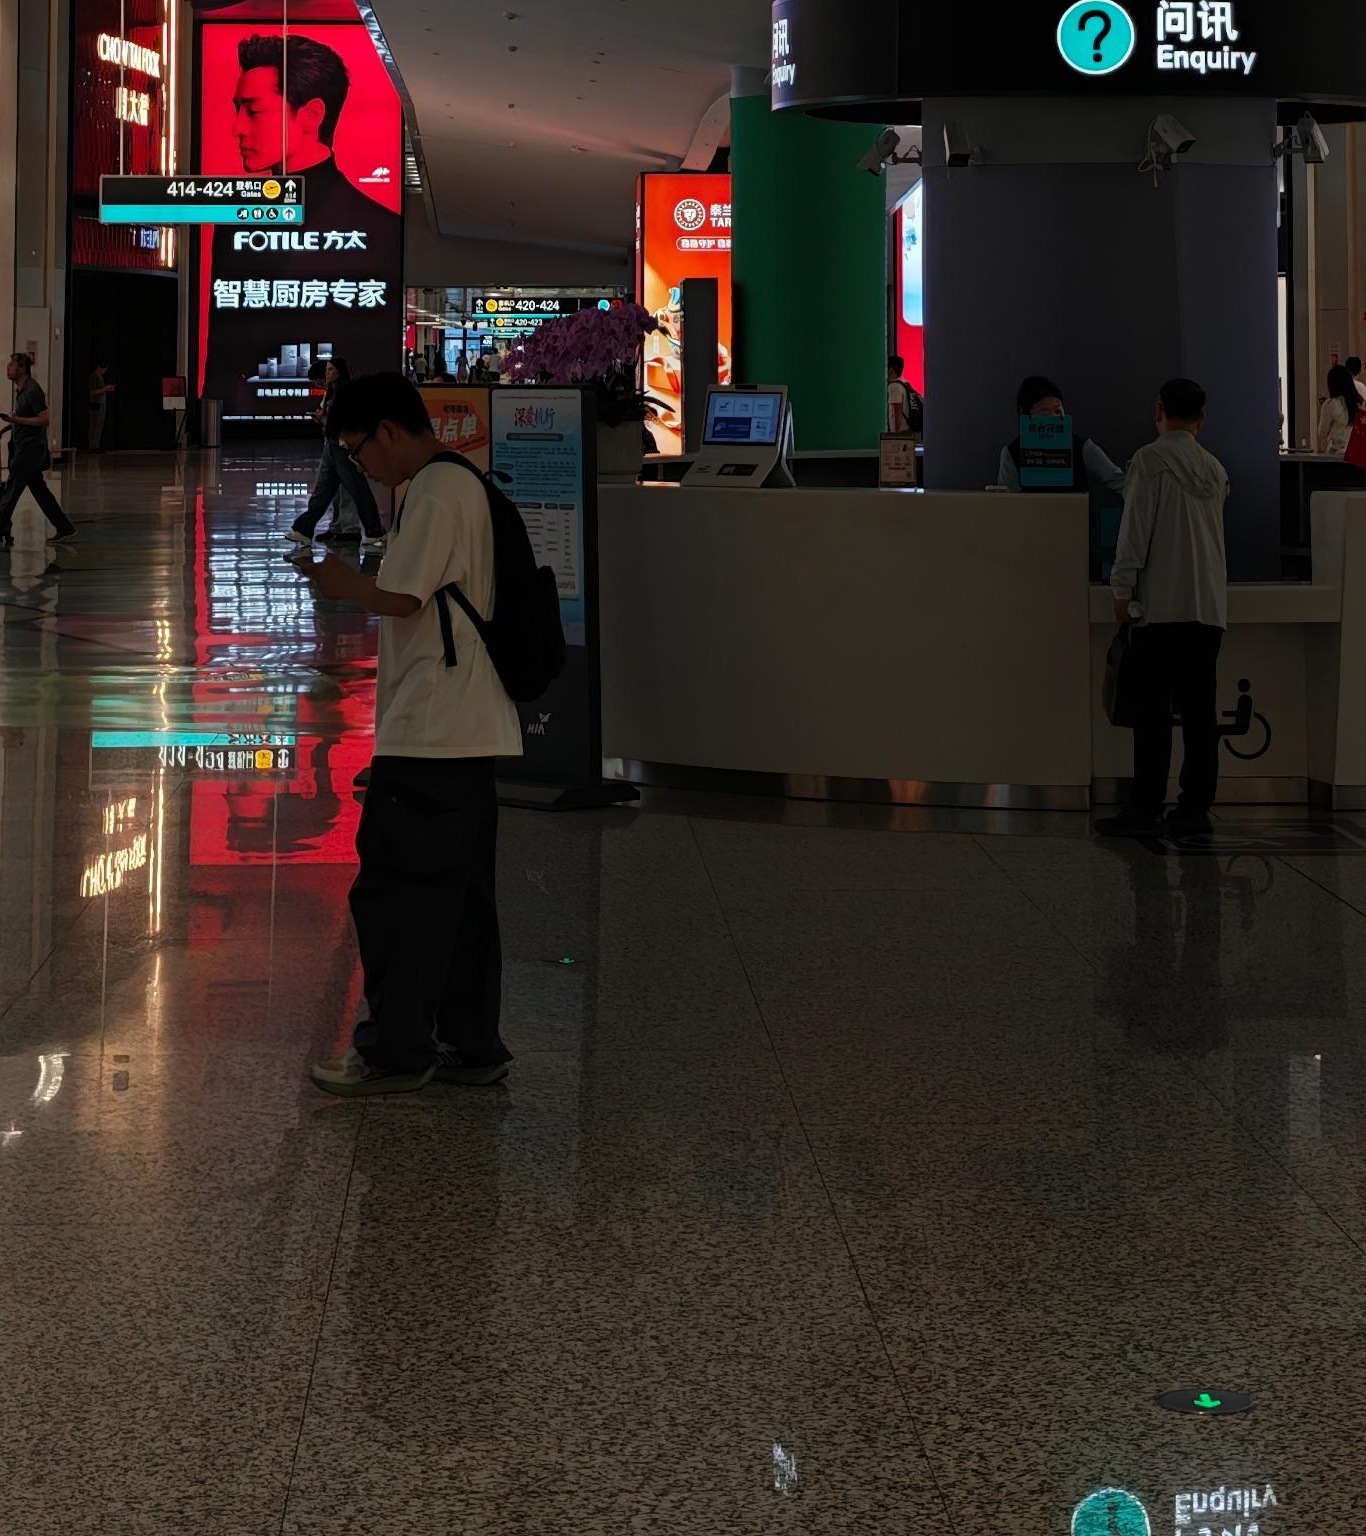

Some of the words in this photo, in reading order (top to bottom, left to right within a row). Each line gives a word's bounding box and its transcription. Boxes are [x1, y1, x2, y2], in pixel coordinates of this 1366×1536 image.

[1156, 0, 1239, 41] 问讯
[1156, 44, 1256, 75] Enquiry
[166, 181, 234, 197] 414-424
[241, 190, 262, 198] Gates
[233, 230, 319, 251] FOTILE
[323, 230, 367, 250] 方太
[213, 278, 387, 309] 智慧厨房专家
[515, 299, 560, 311] 420-424
